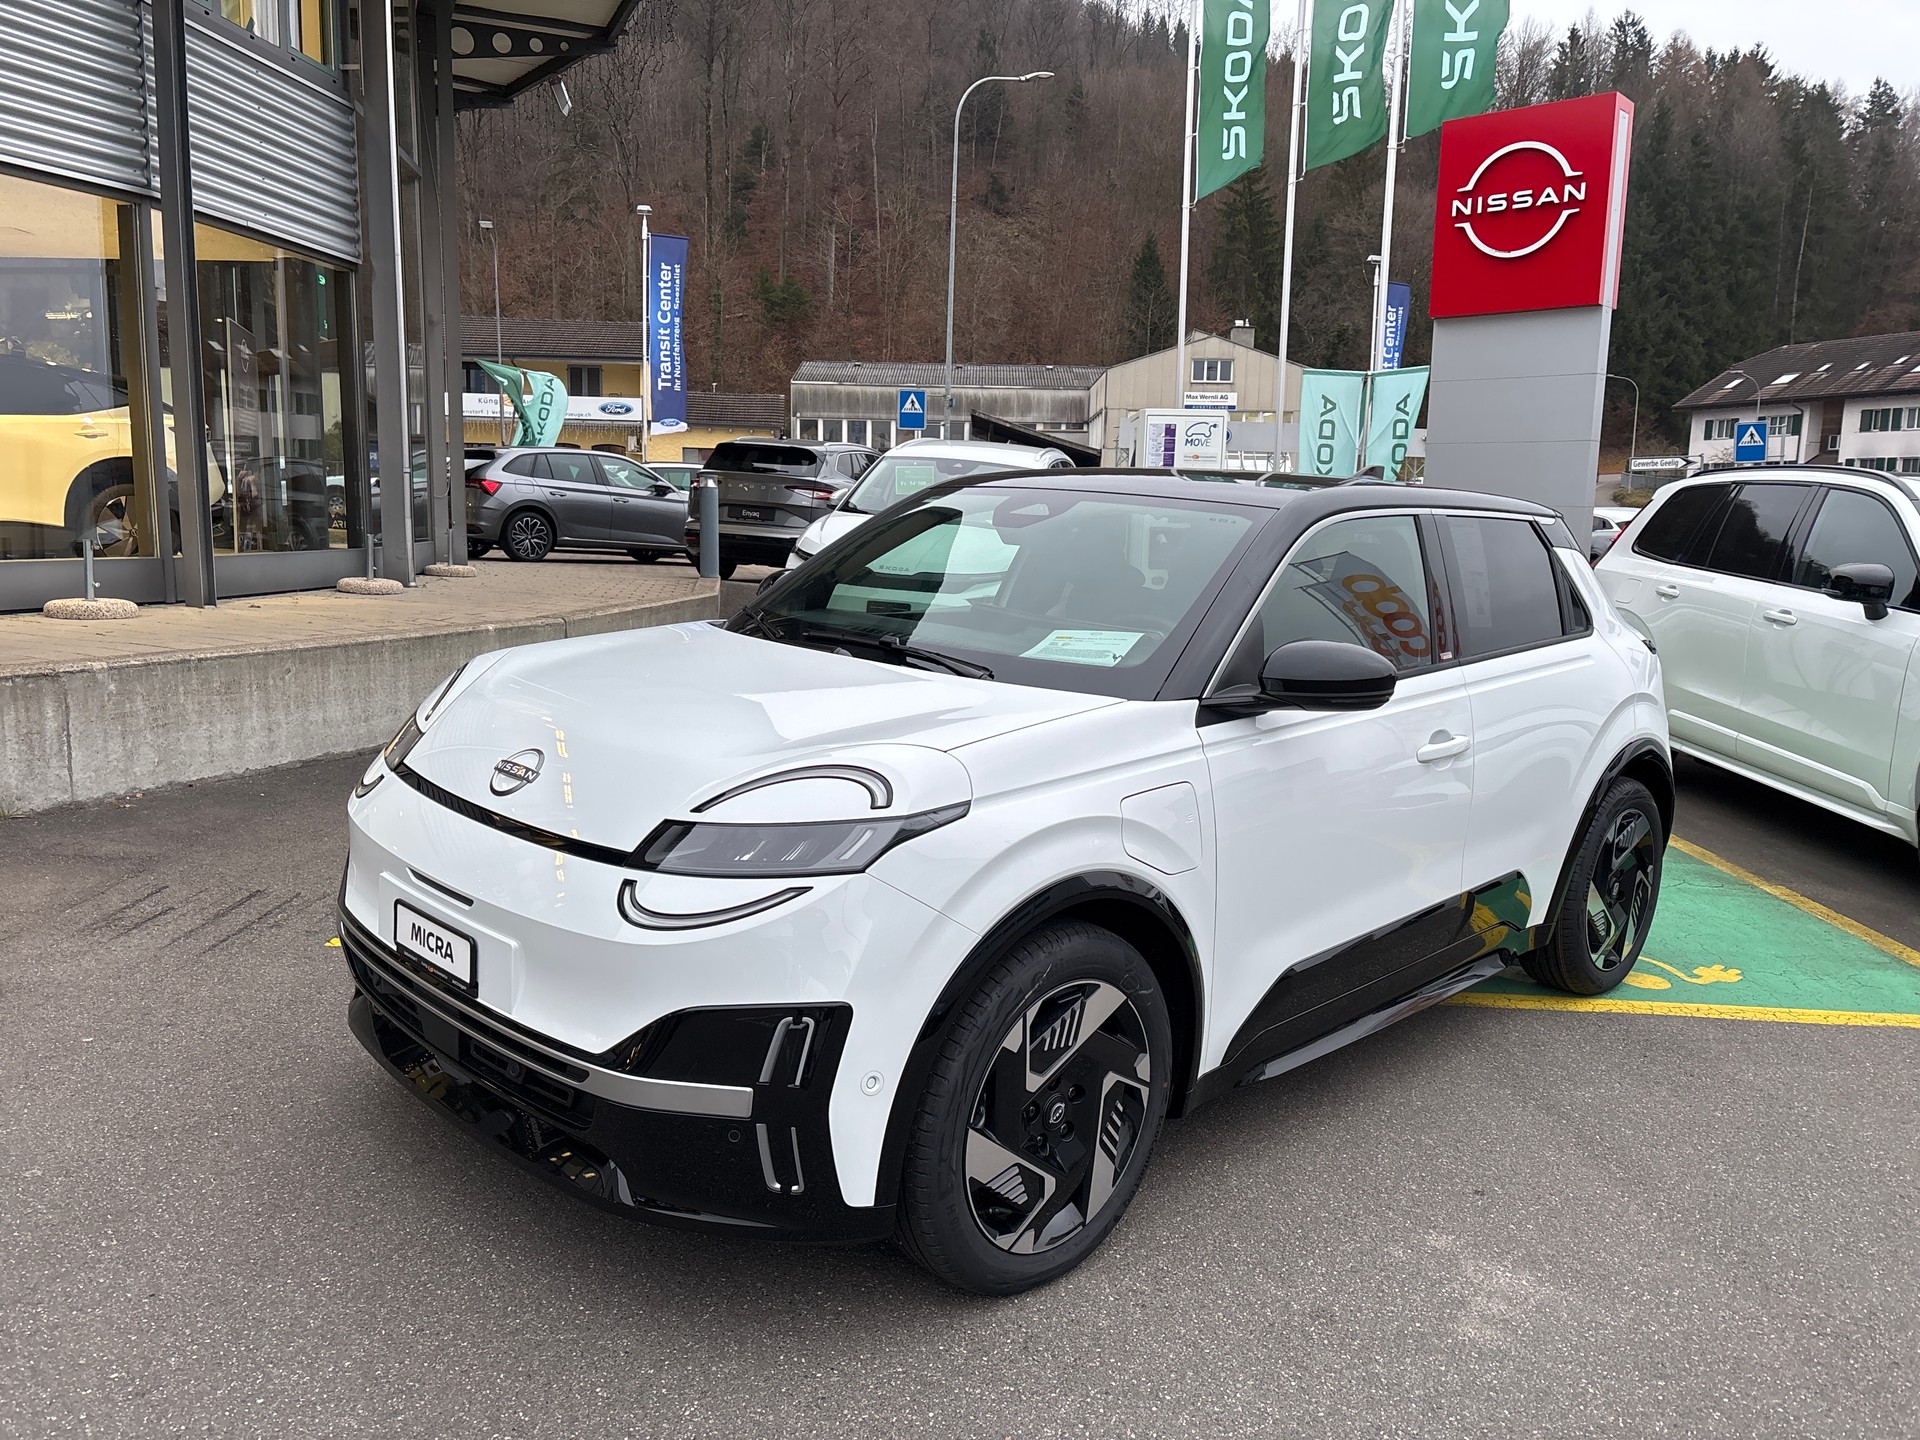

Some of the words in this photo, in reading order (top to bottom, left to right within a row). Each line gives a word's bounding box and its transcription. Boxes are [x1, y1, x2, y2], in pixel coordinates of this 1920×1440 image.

[1451, 182, 1587, 217] NISSAN
[657, 262, 672, 325] Center
[673, 316, 682, 378] Nutzfahrzeug
[1383, 304, 1397, 361] Center
[658, 328, 672, 391] Transit
[477, 397, 499, 406] Küng
[673, 381, 682, 392] Ihr
[534, 378, 556, 446] KODA
[1184, 438, 1212, 447] MOVE
[1633, 460, 1659, 468] Gewerbe
[1660, 459, 1679, 468] Geelig
[742, 509, 760, 518] Enyaq
[498, 760, 538, 781] NISSAN
[410, 921, 455, 964] MICRA
